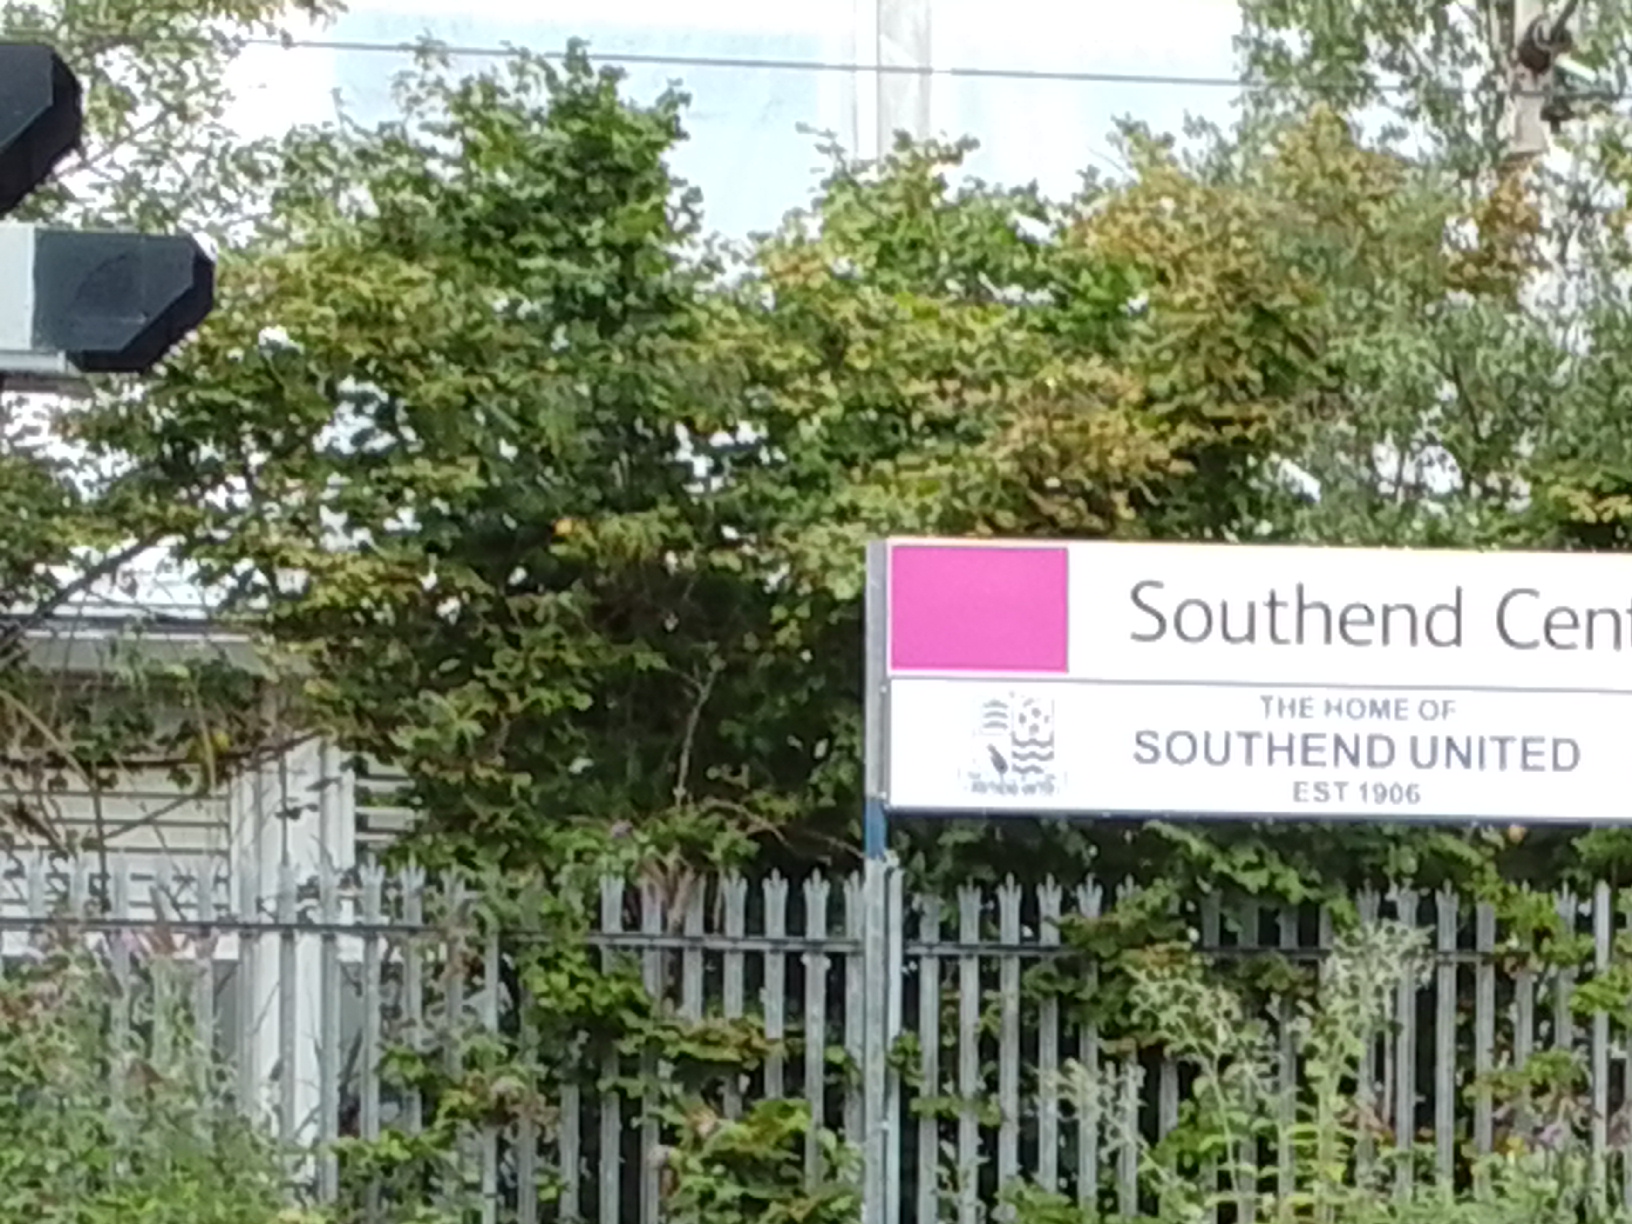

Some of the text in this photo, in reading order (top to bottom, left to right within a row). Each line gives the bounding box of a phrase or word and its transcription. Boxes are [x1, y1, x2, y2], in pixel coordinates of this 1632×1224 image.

[1130, 580, 1463, 648] Southend
[1260, 694, 1457, 722] THE HOME OF
[1132, 729, 1582, 773] SOUTHEND UNITED
[1292, 780, 1422, 805] EST 1906
